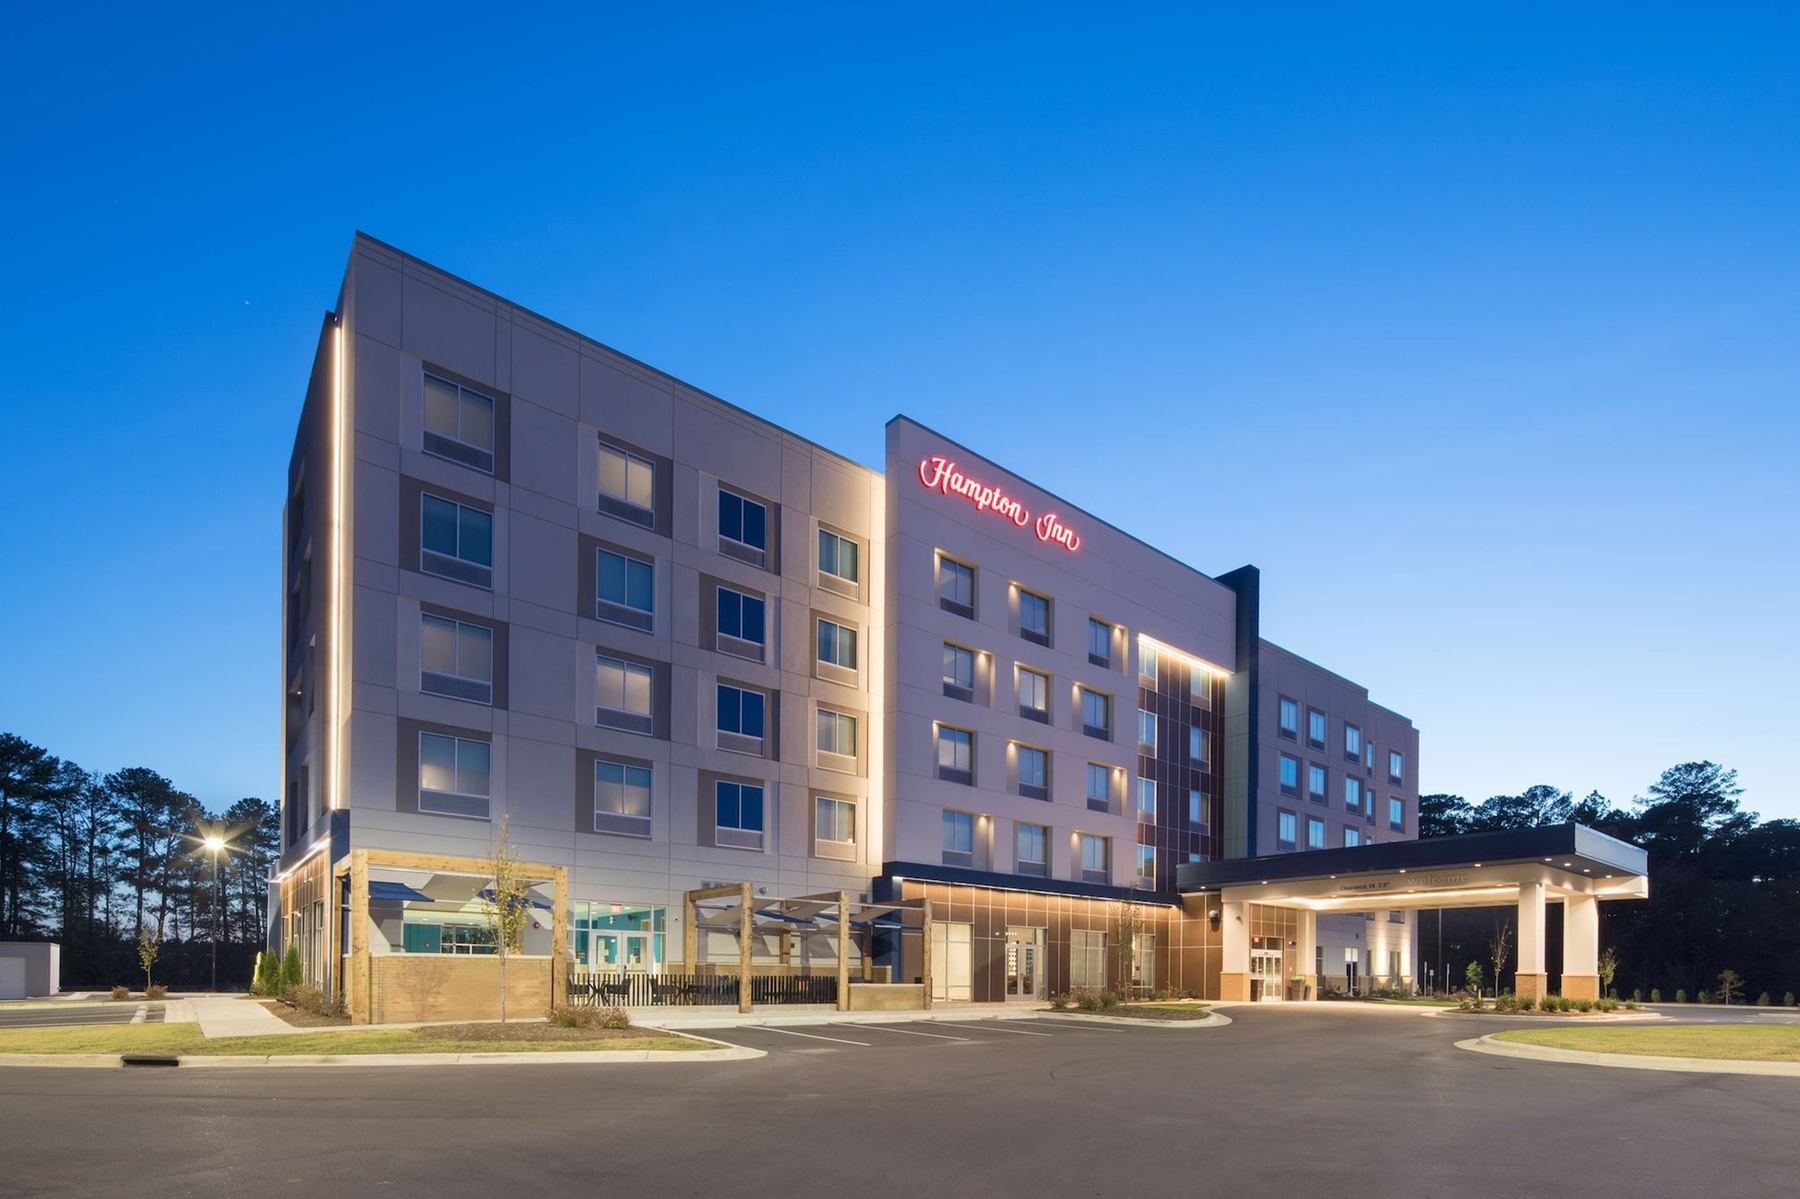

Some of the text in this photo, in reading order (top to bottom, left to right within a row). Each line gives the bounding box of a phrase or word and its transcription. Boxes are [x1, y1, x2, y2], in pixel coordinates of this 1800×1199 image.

[919, 456, 1080, 551] Hampton Inn
[1408, 873, 1469, 886] welcome
